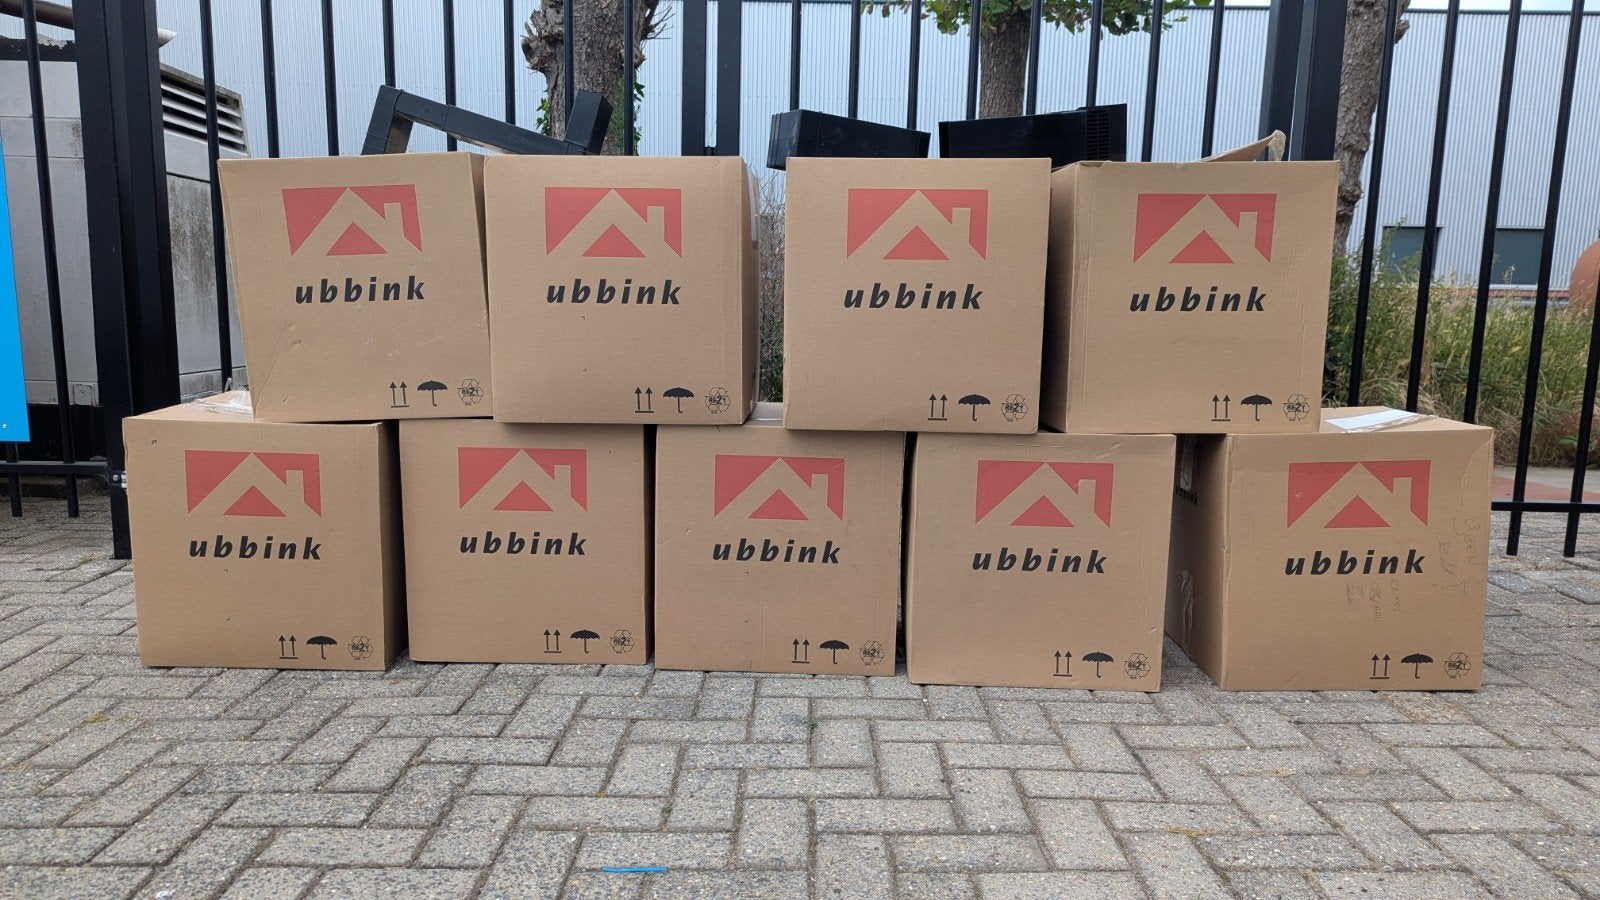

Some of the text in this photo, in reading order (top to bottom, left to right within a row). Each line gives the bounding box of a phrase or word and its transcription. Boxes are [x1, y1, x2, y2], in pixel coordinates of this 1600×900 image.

[296, 276, 424, 304] ubbink
[547, 279, 681, 304] ubbink
[845, 283, 982, 309] ubbink
[1130, 287, 1266, 311] ubbink
[190, 535, 321, 560] ubbink
[460, 531, 586, 555] ubbink
[713, 538, 840, 563] ubbink
[973, 548, 1107, 573] ubbink
[1285, 550, 1425, 575] ubbink
